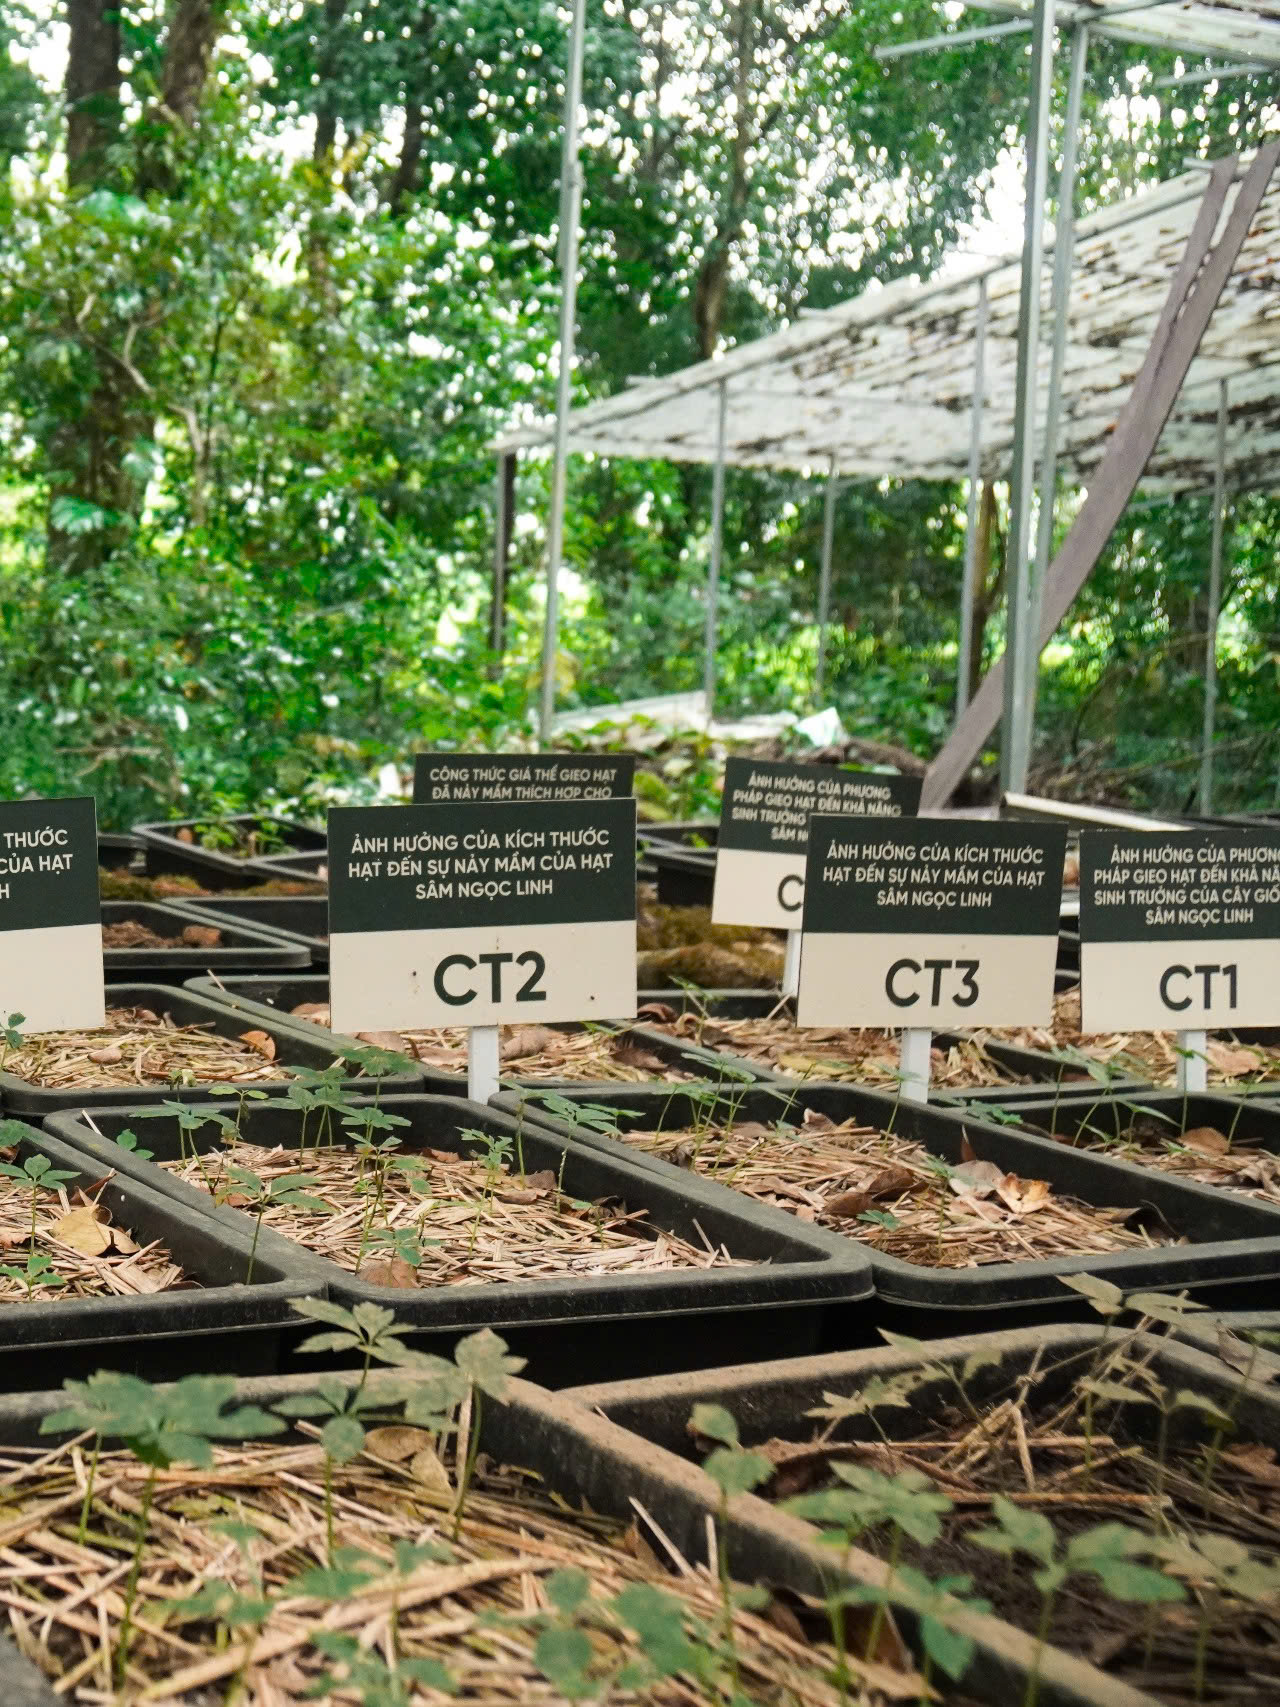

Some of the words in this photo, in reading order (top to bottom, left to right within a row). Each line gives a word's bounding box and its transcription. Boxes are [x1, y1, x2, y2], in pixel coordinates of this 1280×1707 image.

[4, 826, 69, 848] THƯỚC
[352, 834, 388, 853] ẢNH
[393, 831, 458, 852] HƯỞNG
[463, 830, 500, 849] CỦA
[505, 829, 545, 847] KÍCH
[550, 826, 610, 846] THƯỚC
[39, 854, 73, 874] HẠT
[348, 861, 382, 882] HẠT
[387, 855, 422, 876] ĐẾN
[428, 861, 450, 879] SỰ
[454, 855, 489, 873] NẢY
[494, 851, 535, 872] MẦM
[540, 850, 576, 870] CỦA
[581, 853, 613, 874] HẠT
[1133, 868, 1167, 884] GIEO
[416, 881, 453, 899] SÂM
[458, 881, 511, 900] NGỌC
[516, 879, 553, 895] LINH
[960, 892, 992, 907] LINH
[1094, 890, 1125, 905] SINH
[1254, 884, 1280, 903] GIỐ
[1224, 909, 1253, 923] LINH
[434, 951, 546, 1006] CT2
[885, 959, 980, 1007] CT3
[1160, 964, 1238, 1011] CT1
